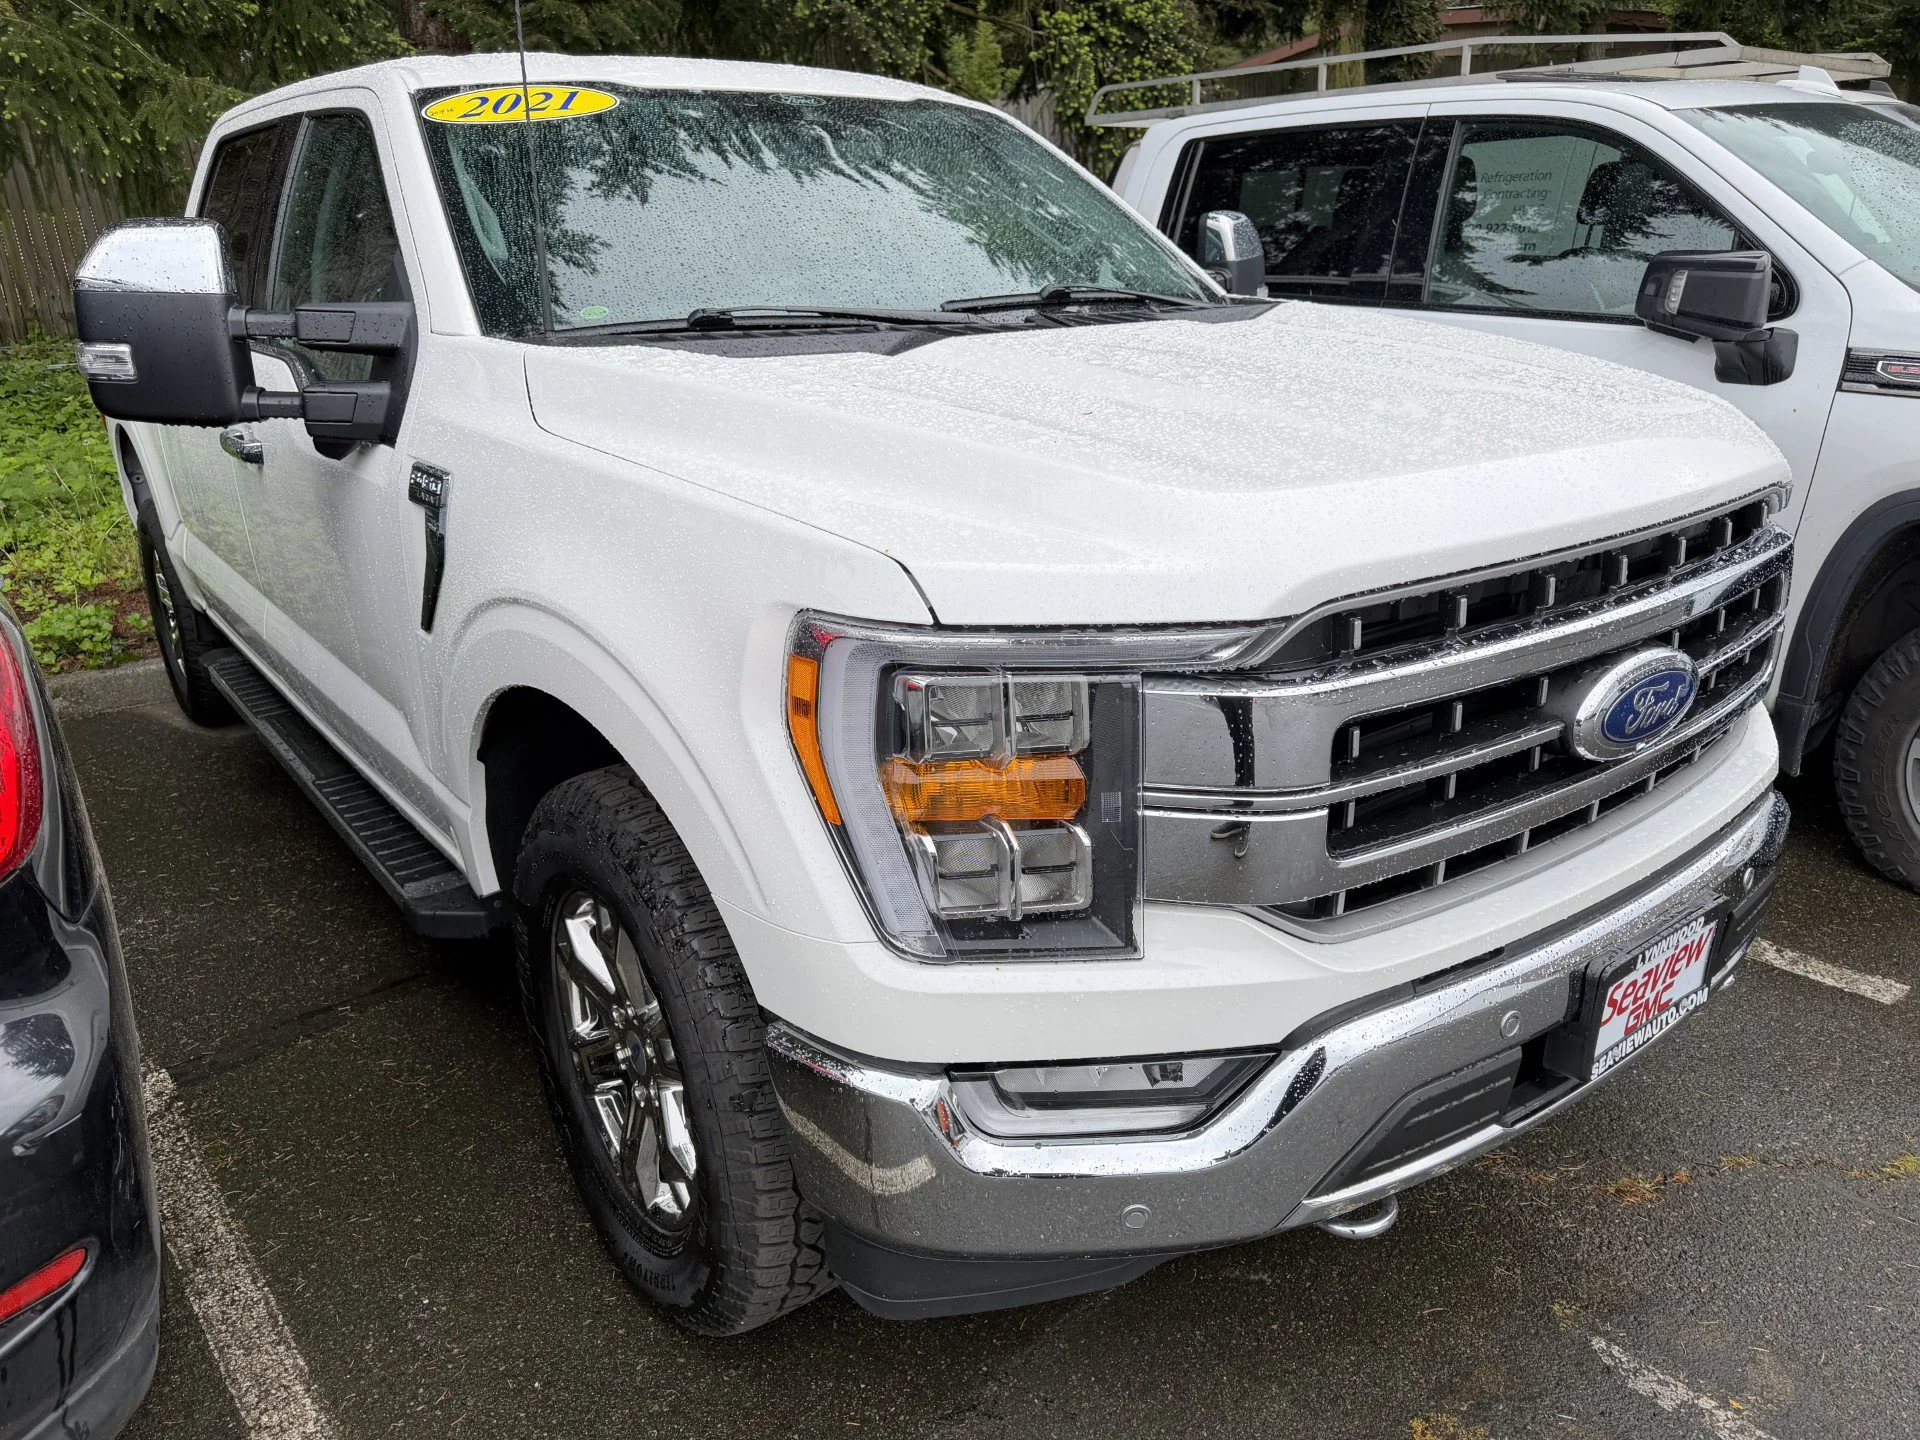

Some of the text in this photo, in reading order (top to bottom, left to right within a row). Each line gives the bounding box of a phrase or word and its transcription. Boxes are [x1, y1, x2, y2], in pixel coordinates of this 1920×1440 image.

[457, 90, 580, 119] 2021
[1480, 169, 1553, 186] Refrigeration
[1483, 187, 1549, 201] Contracting
[1624, 680, 1687, 735] Ford
[1636, 916, 1706, 971] LYNNWOOD
[1623, 980, 1676, 1037] GMC
